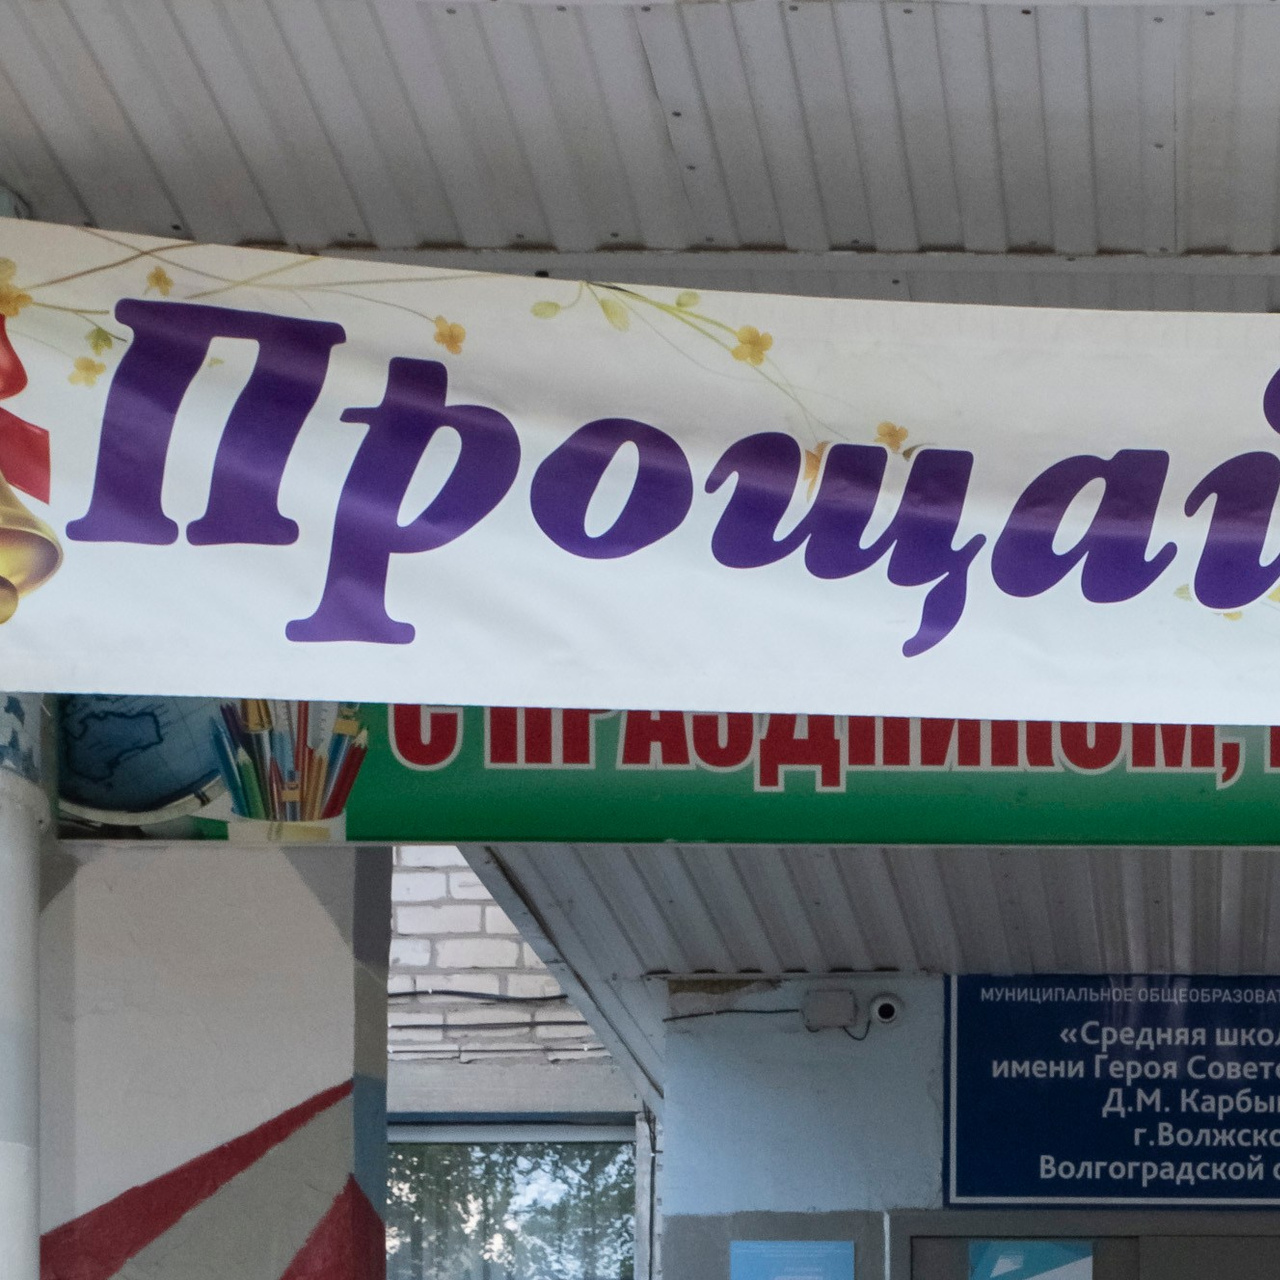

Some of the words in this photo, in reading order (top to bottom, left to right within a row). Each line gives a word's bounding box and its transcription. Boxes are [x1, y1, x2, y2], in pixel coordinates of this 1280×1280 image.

[980, 987, 1133, 1004] МУНИЦИПАЛЬНОЕ
[1059, 1020, 1207, 1053] «Средняя
[992, 1059, 1085, 1079] имени
[1094, 1055, 1178, 1086] Героя
[1101, 1089, 1170, 1118] Д.М.
[1039, 1155, 1264, 1187] Волгоградской
